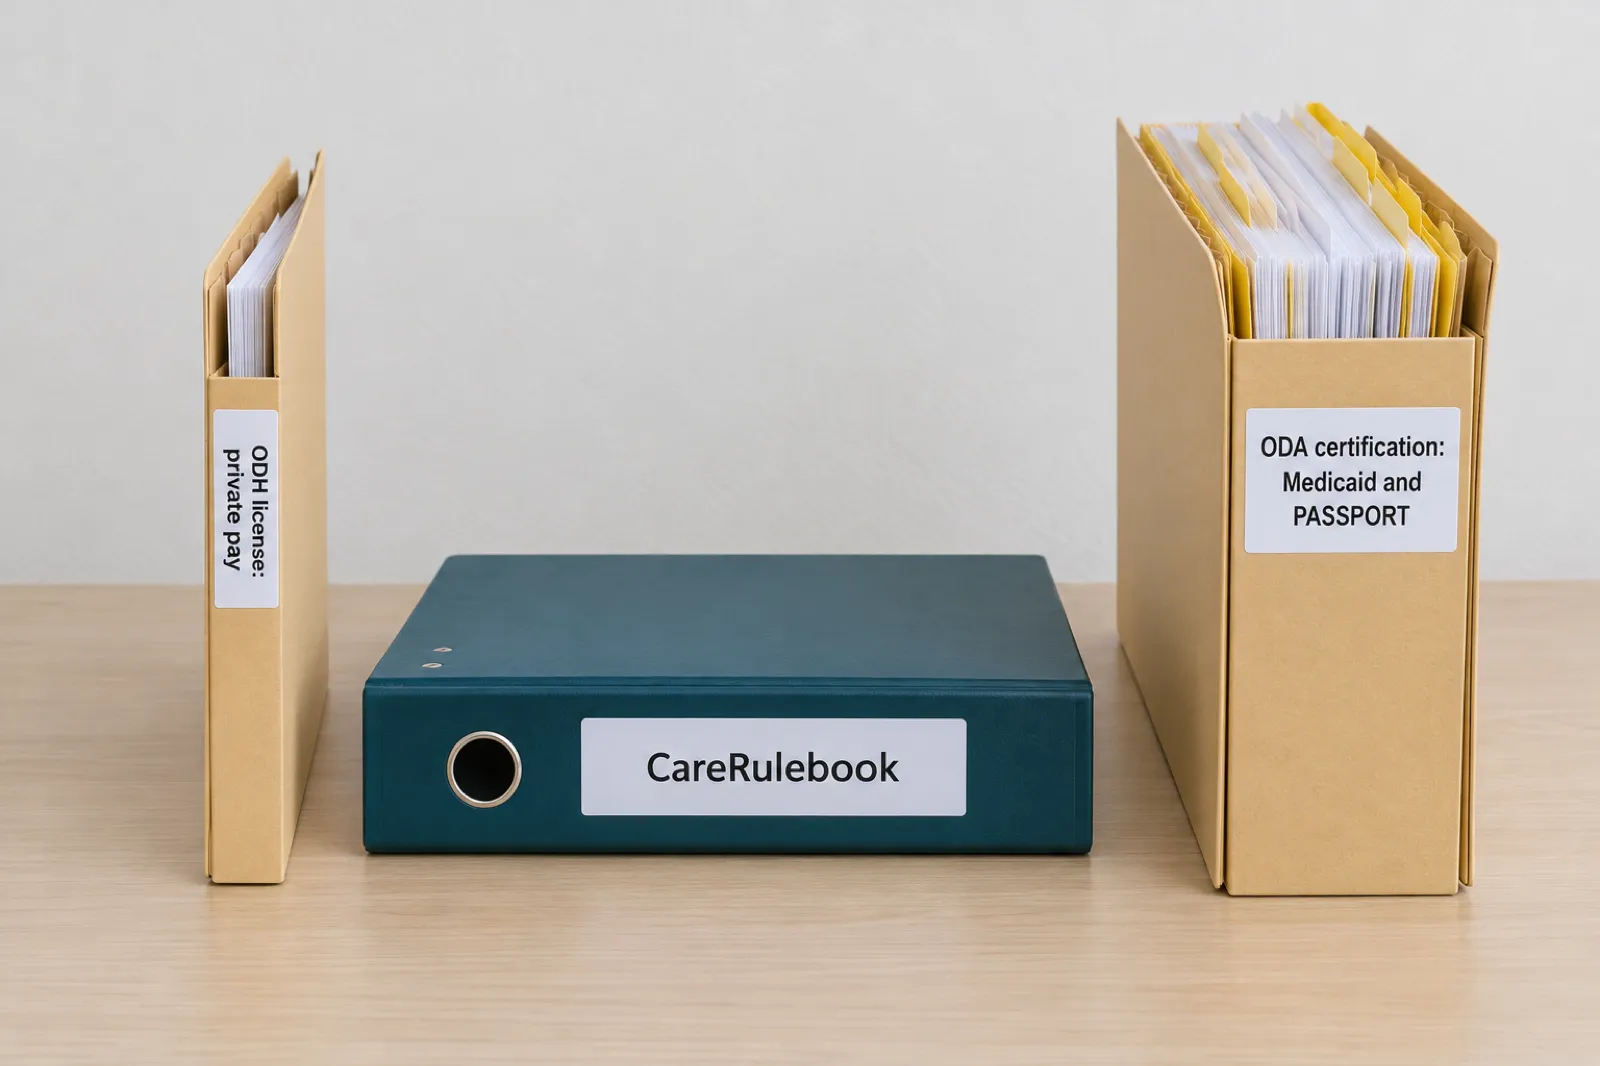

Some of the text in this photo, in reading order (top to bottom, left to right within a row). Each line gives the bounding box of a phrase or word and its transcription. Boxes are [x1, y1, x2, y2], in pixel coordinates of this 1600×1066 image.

[1260, 435, 1445, 458] ODA certification:
[1283, 470, 1422, 492] Medicaid and
[222, 449, 245, 572] private pay
[251, 445, 269, 578] ODH license:
[1293, 504, 1411, 527] PASSPORT
[647, 751, 900, 783] CareRulebook
